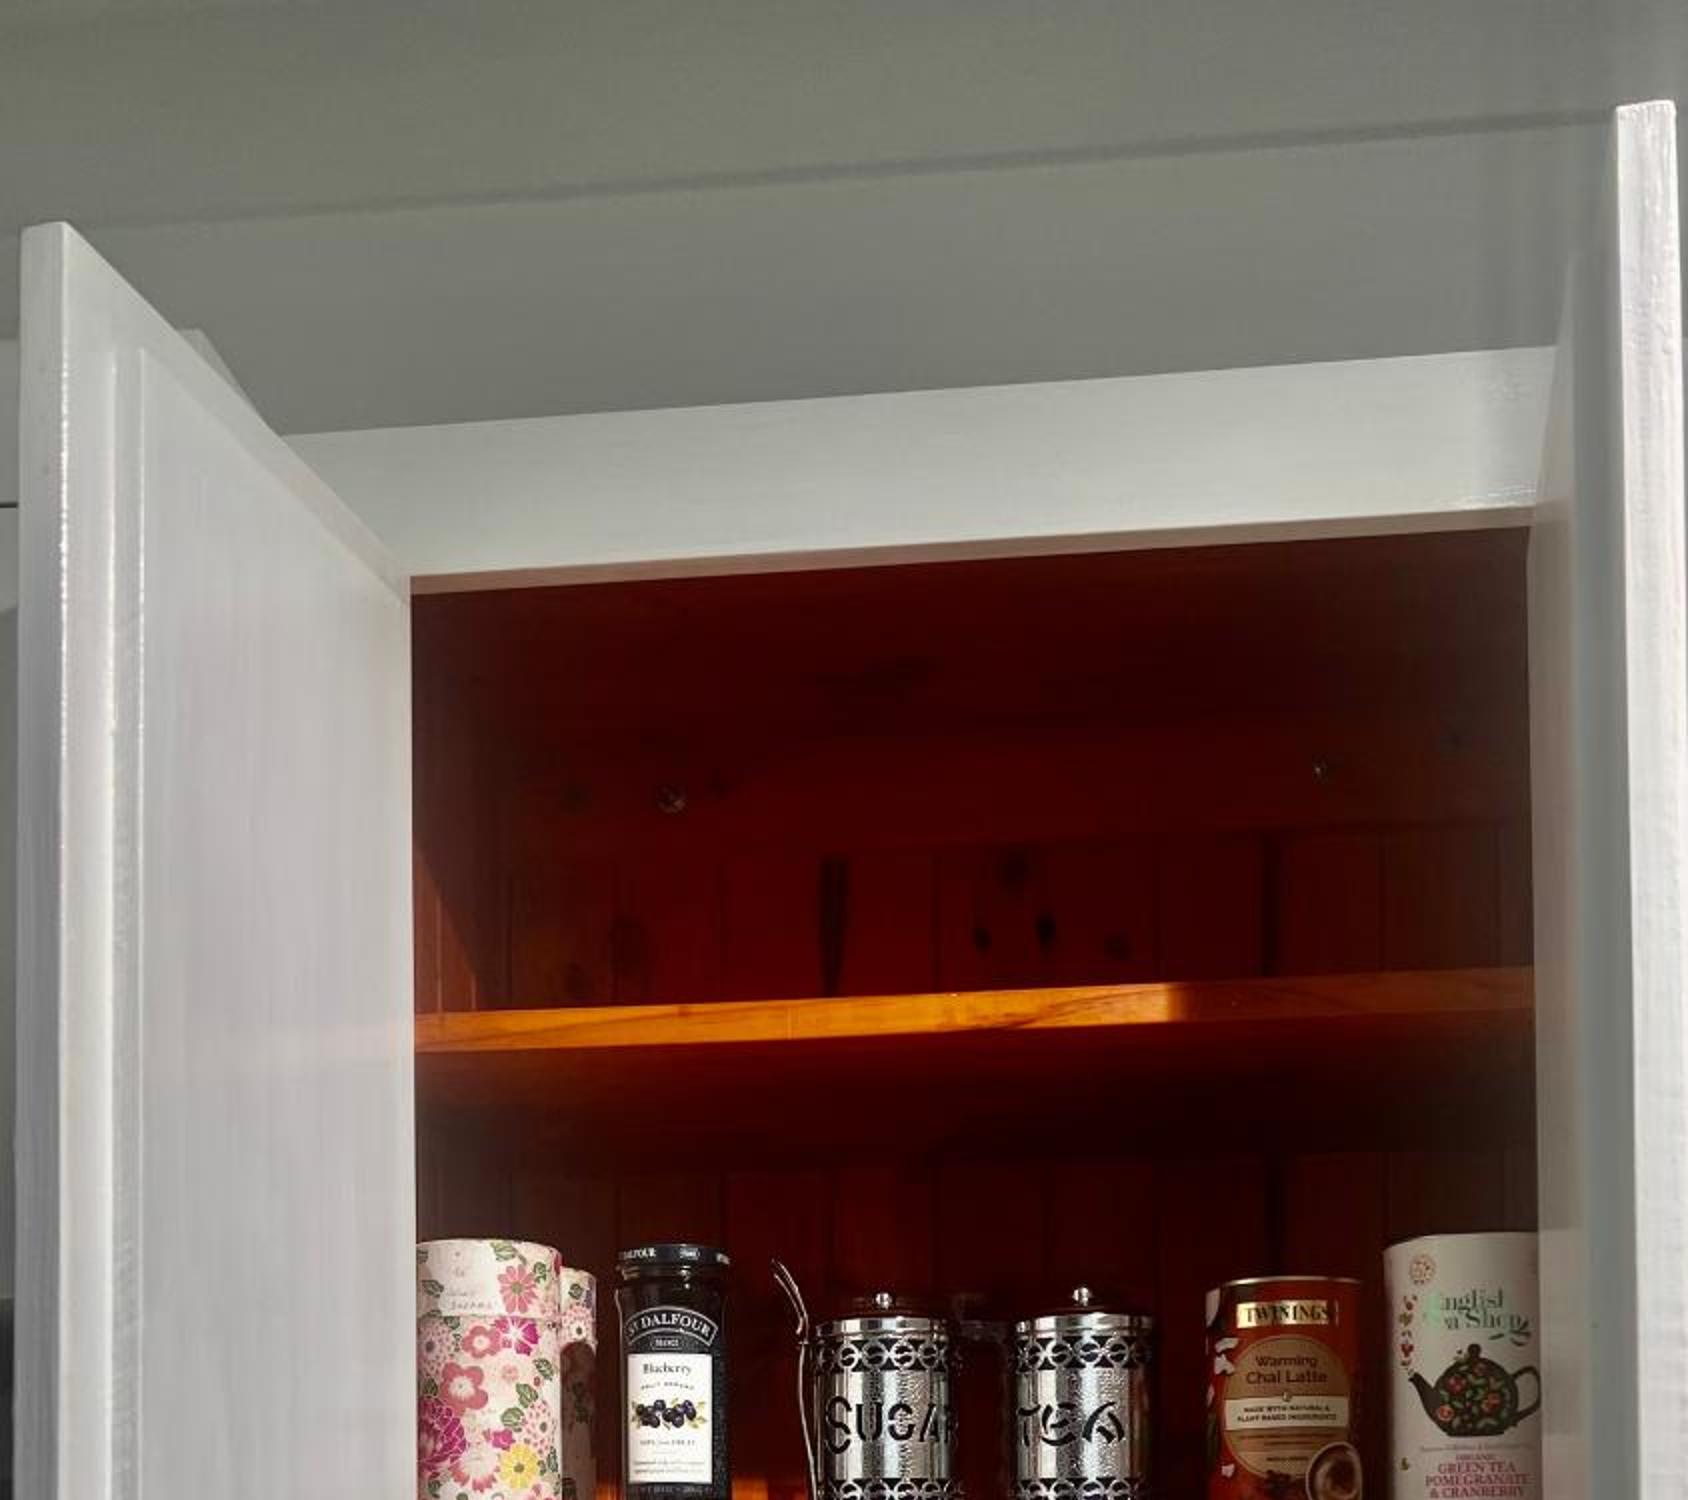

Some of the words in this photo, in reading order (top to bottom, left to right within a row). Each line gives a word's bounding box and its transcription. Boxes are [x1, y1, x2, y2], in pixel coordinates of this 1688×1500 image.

[1244, 1304, 1330, 1323] TWININGS
[641, 1312, 712, 1337] DALFOUR
[1255, 1356, 1318, 1369] Warming
[1285, 1369, 1328, 1384] Latte
[1018, 1402, 1125, 1448] TEA
[1438, 1461, 1484, 1474] GREEN
[1487, 1460, 1516, 1473] TEA
[1425, 1472, 1532, 1487] POMEGRANATE
